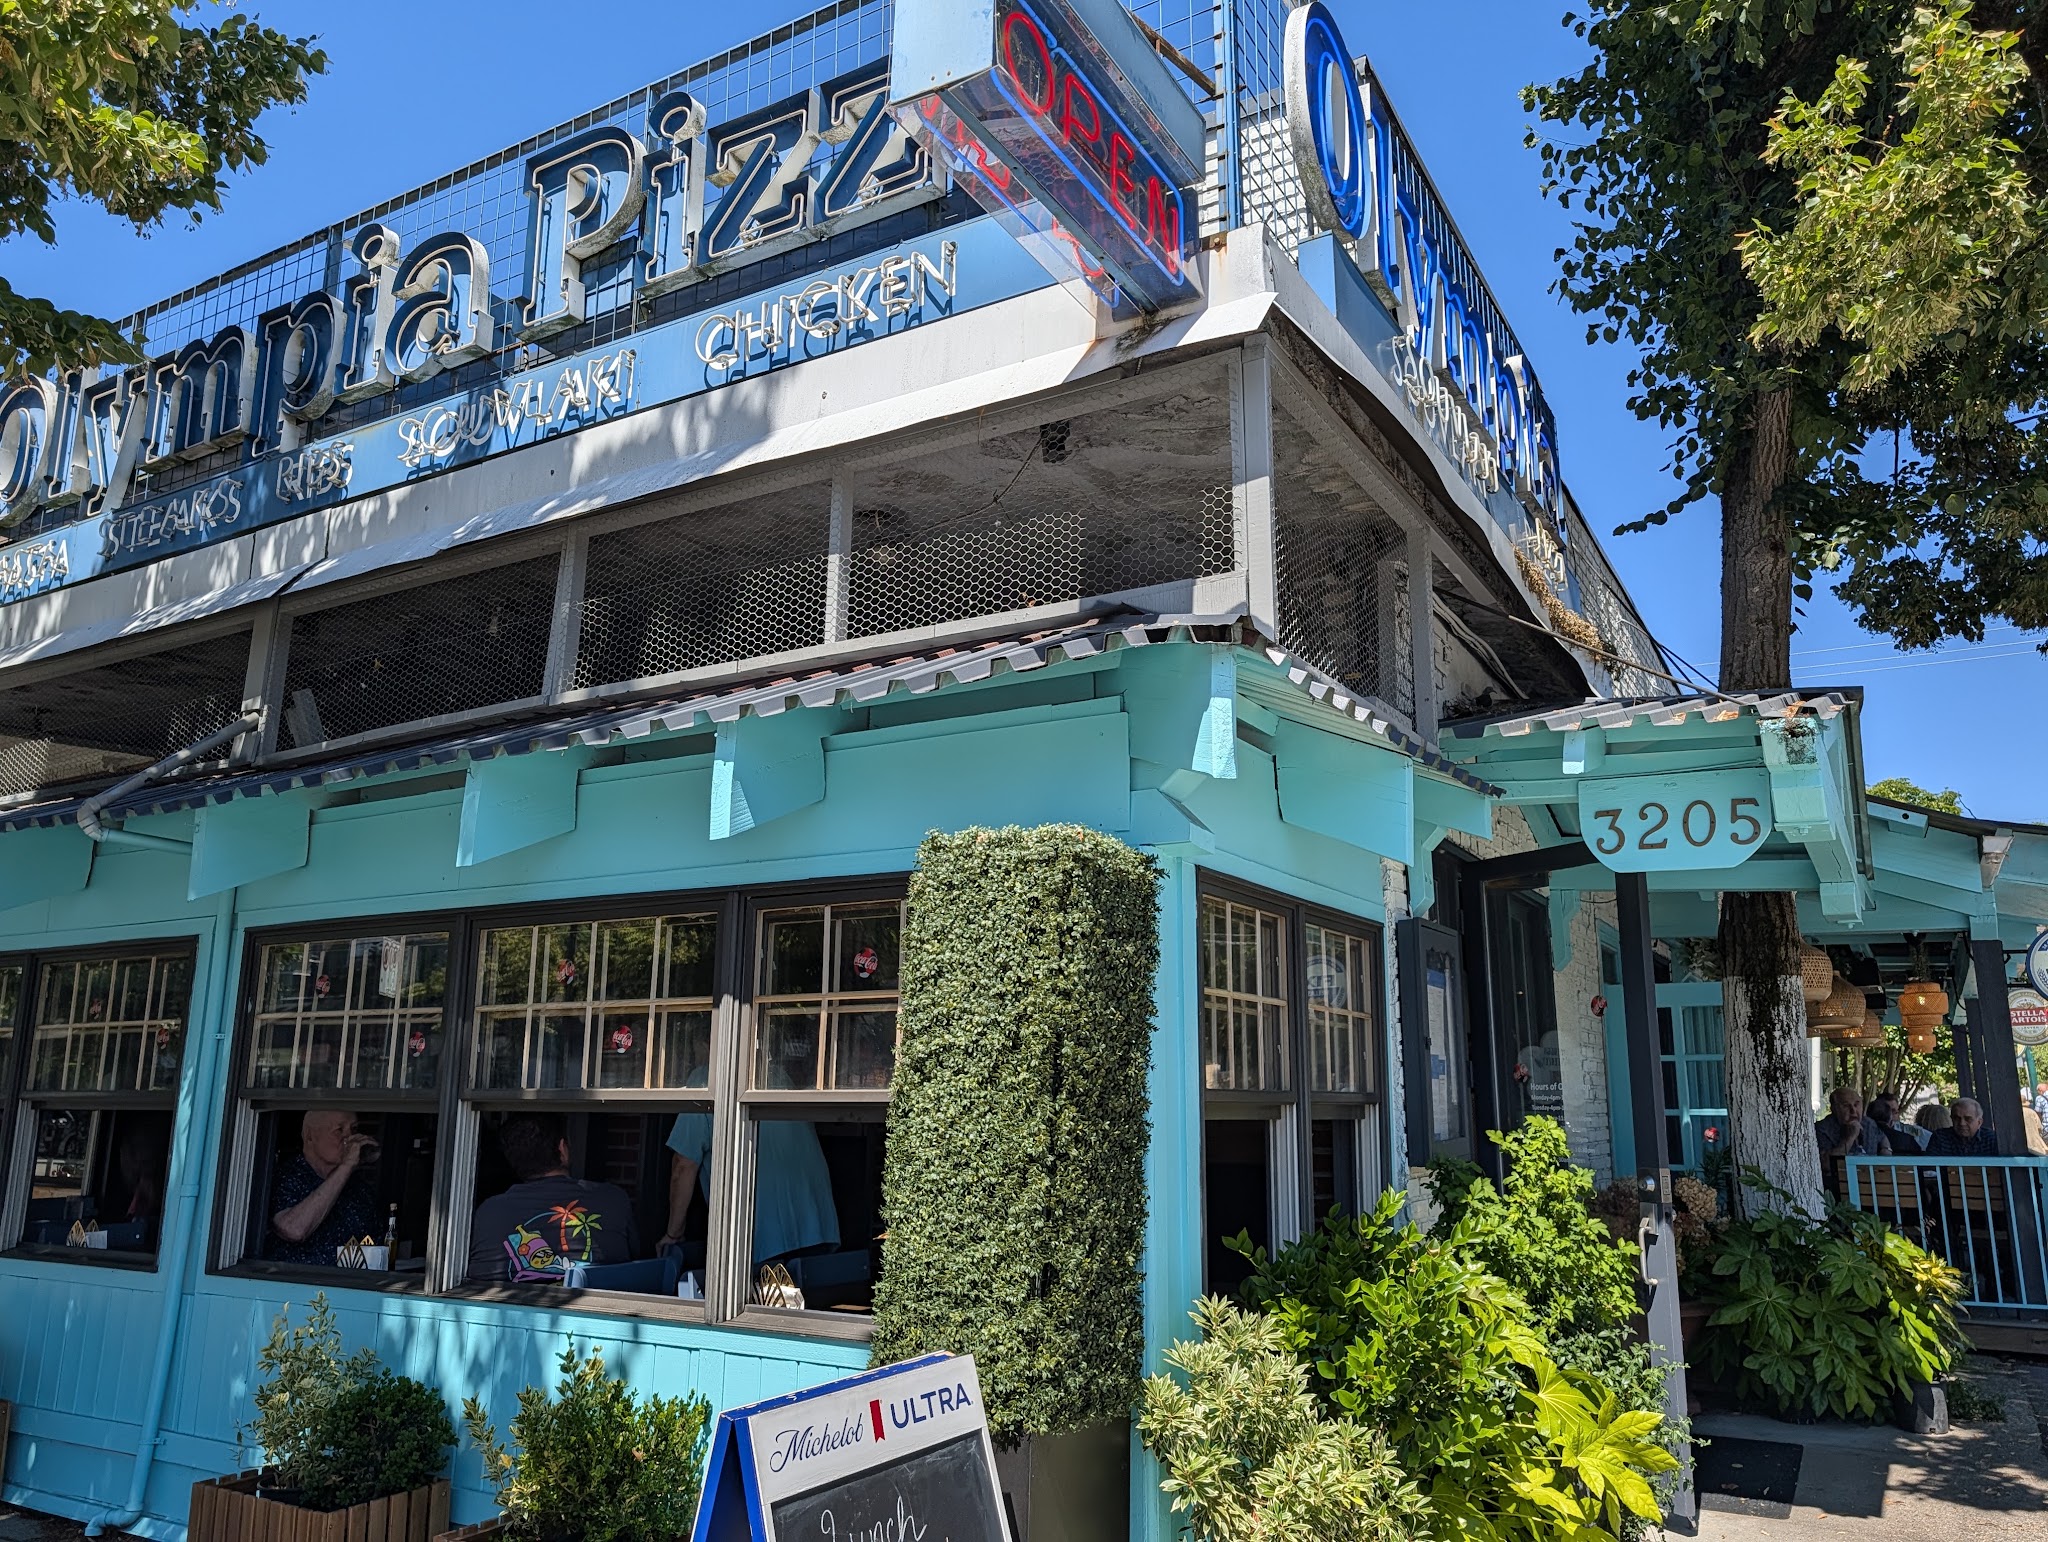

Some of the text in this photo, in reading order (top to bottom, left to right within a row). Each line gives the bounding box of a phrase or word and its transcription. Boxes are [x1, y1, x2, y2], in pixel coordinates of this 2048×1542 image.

[1003, 12, 1179, 274] OPEN
[511, 56, 985, 341] Pizz
[0, 241, 957, 594] ASTA STEAKS RIBS SOUVLAKI CHICKEN
[1594, 798, 1761, 854] 3205
[2011, 1016, 2047, 1024] ARTOIS
[1530, 1082, 1549, 1091] Hours
[1549, 1082, 1558, 1091] of
[769, 1383, 972, 1473] Michelob ULTRA
